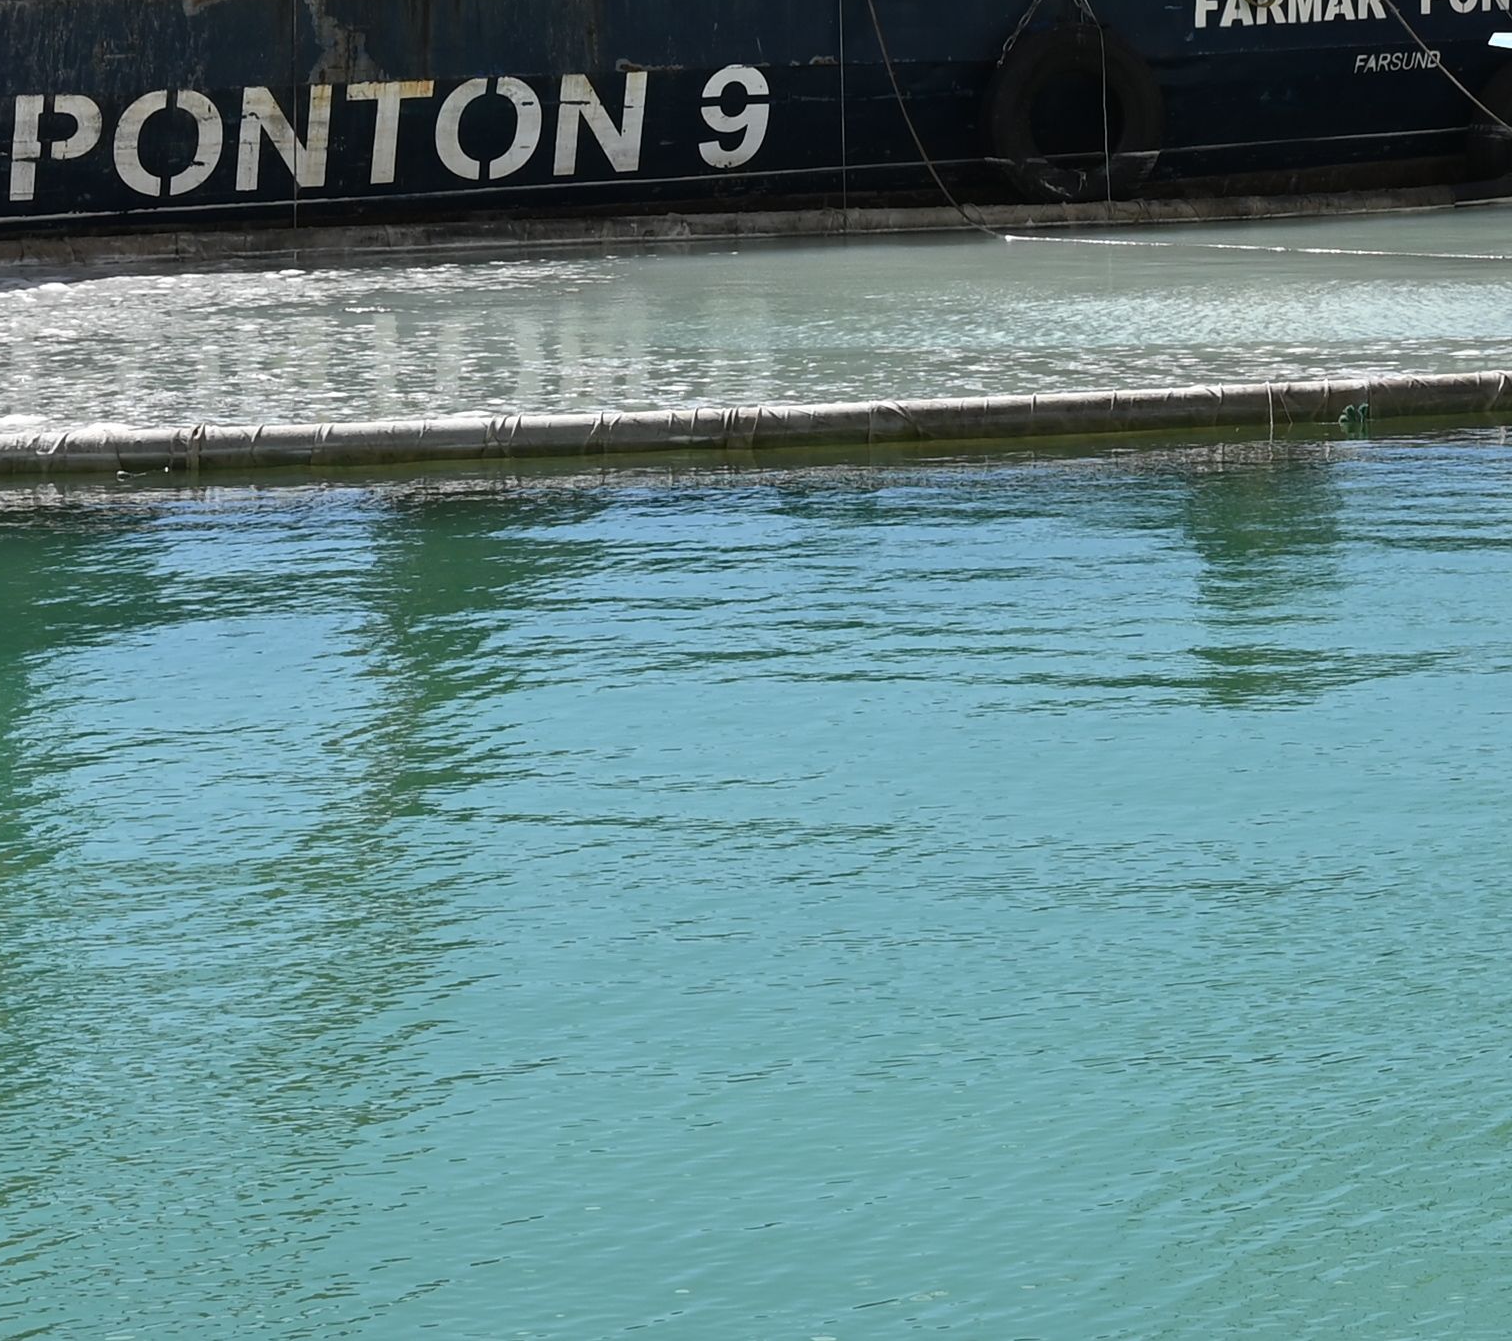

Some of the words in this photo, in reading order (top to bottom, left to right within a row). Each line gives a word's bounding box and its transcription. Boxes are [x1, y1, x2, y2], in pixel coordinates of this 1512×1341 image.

[1353, 50, 1440, 74] FARSUND
[9, 69, 648, 202] PONTON
[698, 64, 771, 169] 9
